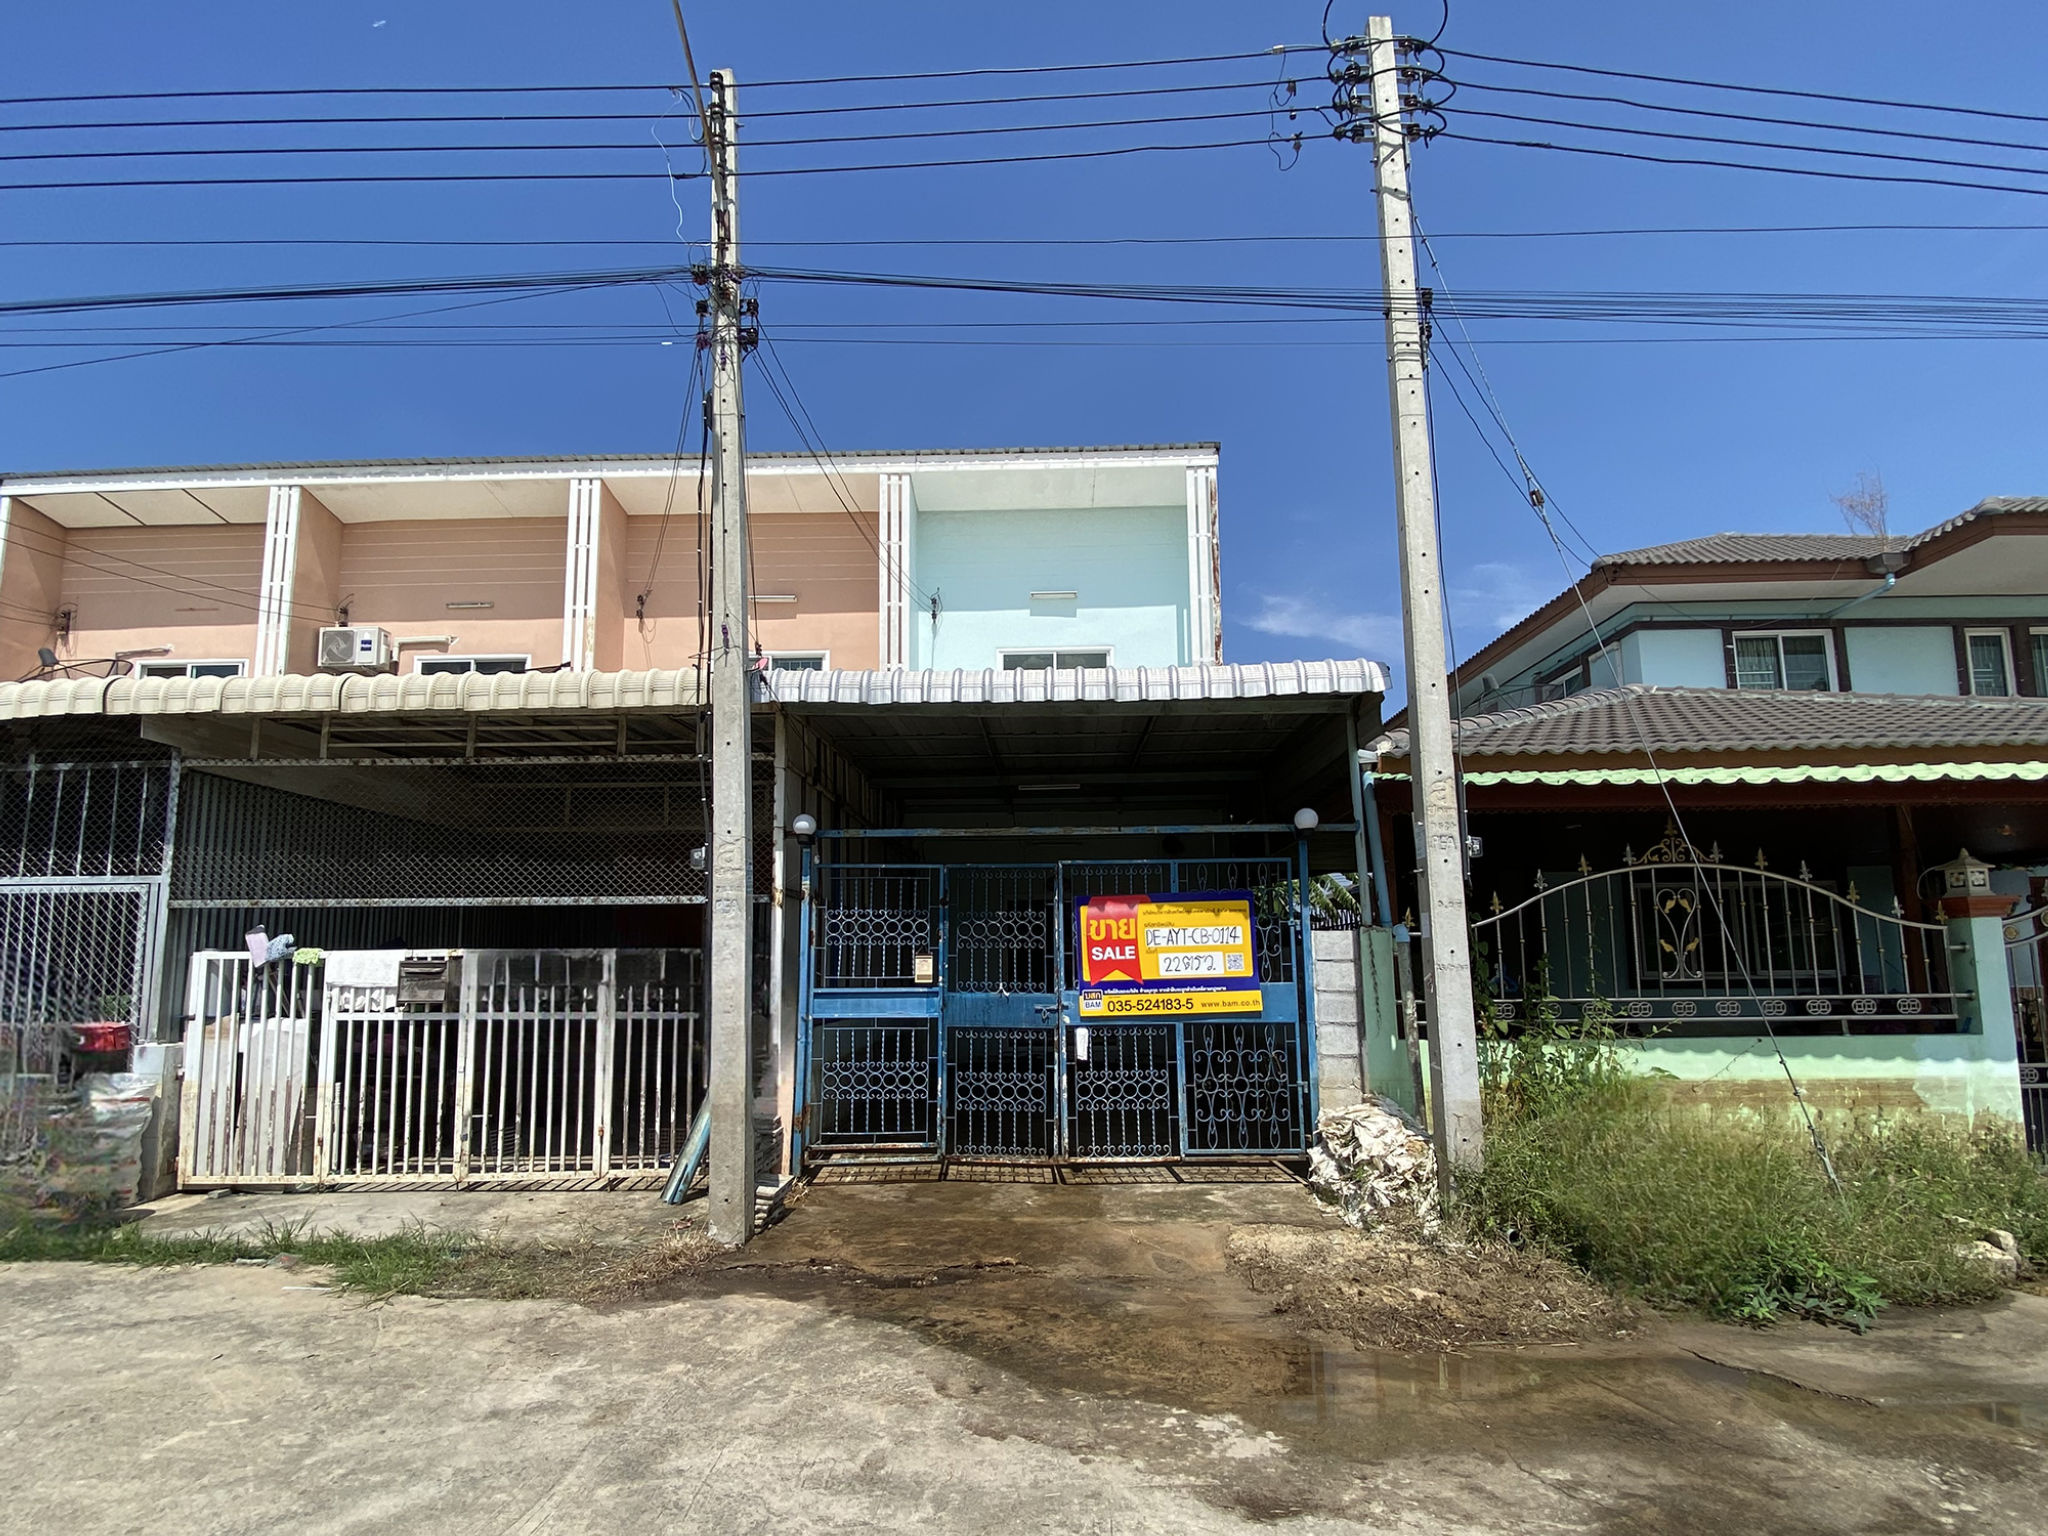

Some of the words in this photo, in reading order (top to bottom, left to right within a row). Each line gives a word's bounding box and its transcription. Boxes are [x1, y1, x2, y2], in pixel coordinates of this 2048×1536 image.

[1089, 918, 1136, 941] ขาย
[1145, 926, 1240, 946] DE-AYT-CB-0114
[1091, 945, 1136, 961] SALE
[1085, 1001, 1102, 1009] BAM
[1107, 998, 1194, 1012] 035-524183-5
[1200, 999, 1261, 1008] www.bam.co.th
